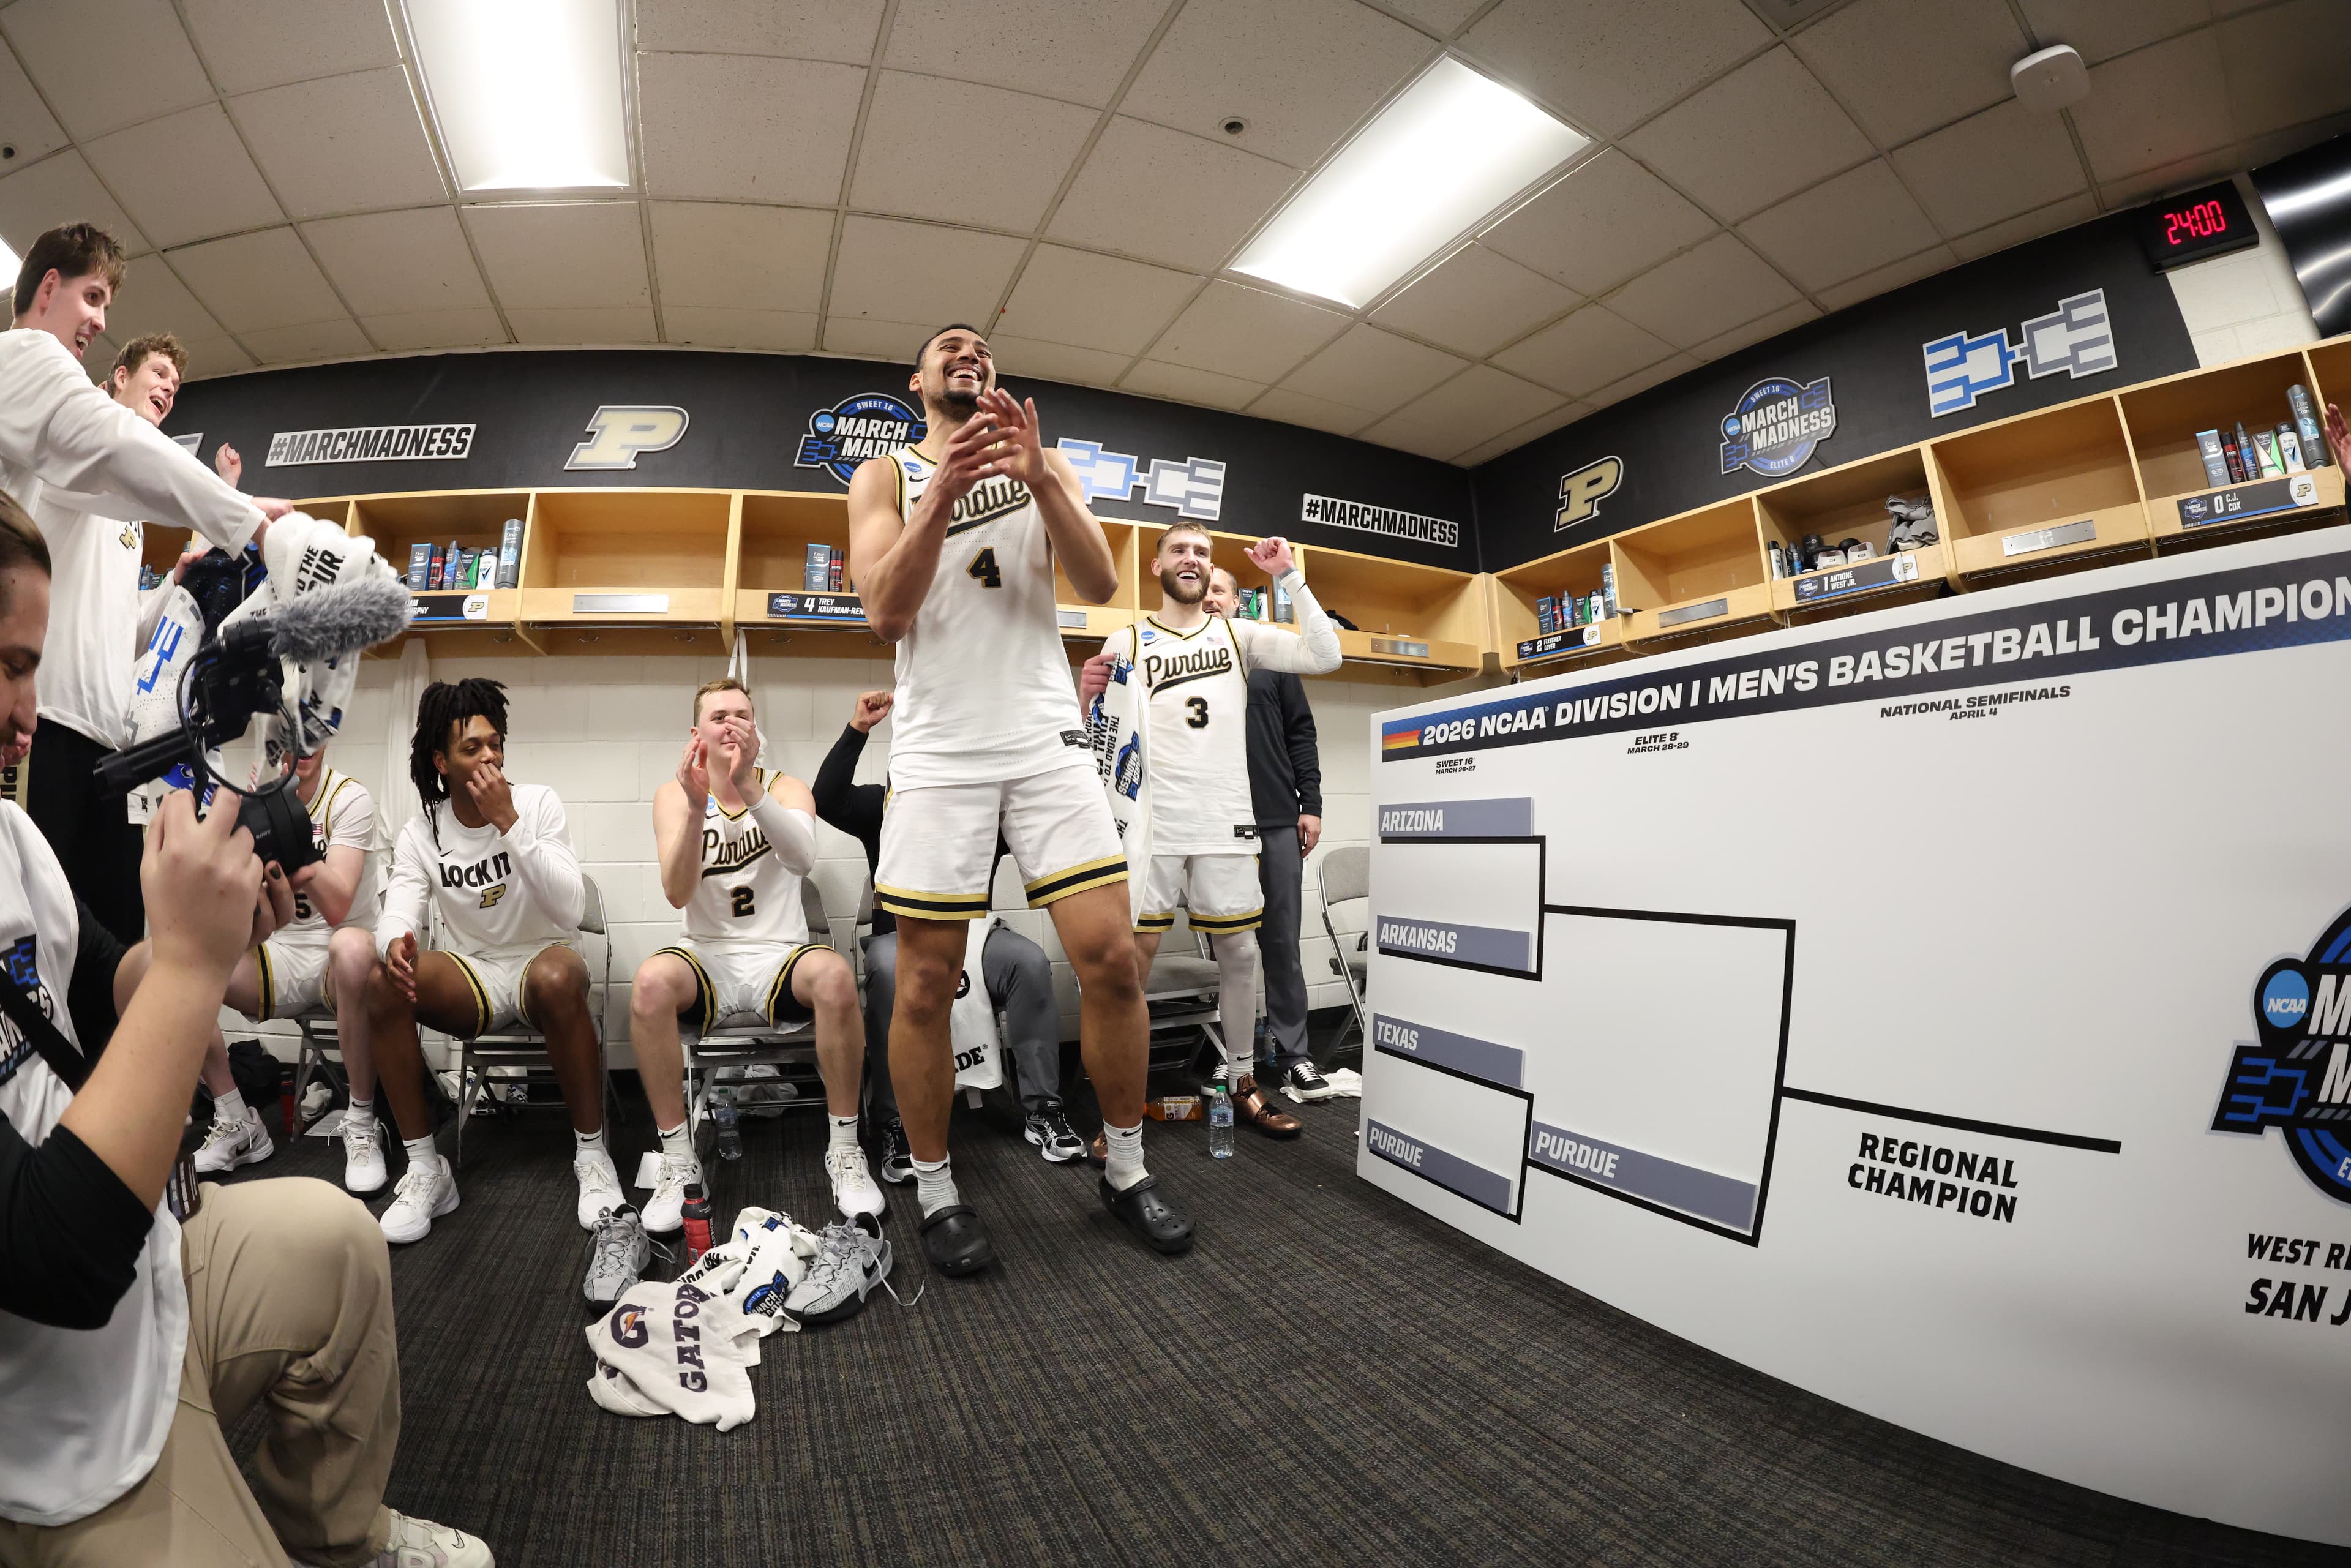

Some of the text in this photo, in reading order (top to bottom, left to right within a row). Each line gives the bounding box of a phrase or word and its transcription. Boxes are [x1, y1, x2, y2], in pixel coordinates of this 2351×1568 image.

[2164, 200, 2226, 244] 24:00
[857, 401, 882, 410] SWEET
[1750, 386, 1770, 402] SWEET
[834, 416, 909, 440] MARCH
[1742, 397, 1798, 433] MARCH
[1753, 407, 1831, 451] MADNESS
[269, 427, 471, 463] #MARCHMADNESS
[568, 407, 686, 468] P
[1770, 460, 1789, 468] ELITE
[1556, 457, 1622, 529] P
[2214, 493, 2238, 514] 0 C.J.
[2229, 502, 2241, 512] COX
[1306, 499, 1457, 545] #MARCHMADNESS
[299, 545, 319, 575] THE
[966, 546, 1001, 588] 4
[1824, 571, 1853, 591] 1 ANTIONE
[1831, 581, 1846, 590] WEST
[804, 598, 816, 612] 4
[817, 606, 865, 615] KAUFMAN-REN
[1537, 640, 1542, 652] 2
[1145, 646, 1232, 688] Purdue
[1423, 718, 1475, 746] 2026
[1554, 682, 1682, 727] DIVISION
[1690, 680, 1701, 707] I
[1708, 661, 1819, 704] MEN'S
[1828, 616, 2099, 687] BASKETBALL
[1185, 696, 1209, 729] 3
[1880, 685, 2071, 718] NATIONAL SEMIFINALS
[1950, 708, 1998, 720] APRIL 4
[1109, 715, 1119, 735] THE
[1635, 733, 1667, 746] ELITE
[1106, 735, 1116, 761] ROAD
[1627, 741, 1689, 754] MARCH 28-29
[1103, 763, 1111, 776] TO
[1118, 750, 1138, 795] MADNESS
[1436, 759, 1463, 768] SWEET
[1381, 809, 1444, 832] ARIZONA
[702, 826, 768, 865] Purdu
[438, 852, 511, 888] LOCK IT
[730, 886, 755, 918] 2
[1379, 923, 1457, 954] ARKANSAS
[2267, 998, 2306, 1014] NCAA
[1377, 1020, 1419, 1051] TEXAS
[1369, 1127, 1423, 1167] PURDUE
[1535, 1131, 1619, 1179] PURDUE
[1859, 1132, 2018, 1188] REGIONAL
[1848, 1163, 2018, 1223] CHAMPION
[2248, 1233, 2320, 1266] WEST
[2245, 1278, 2329, 1322] SAN
